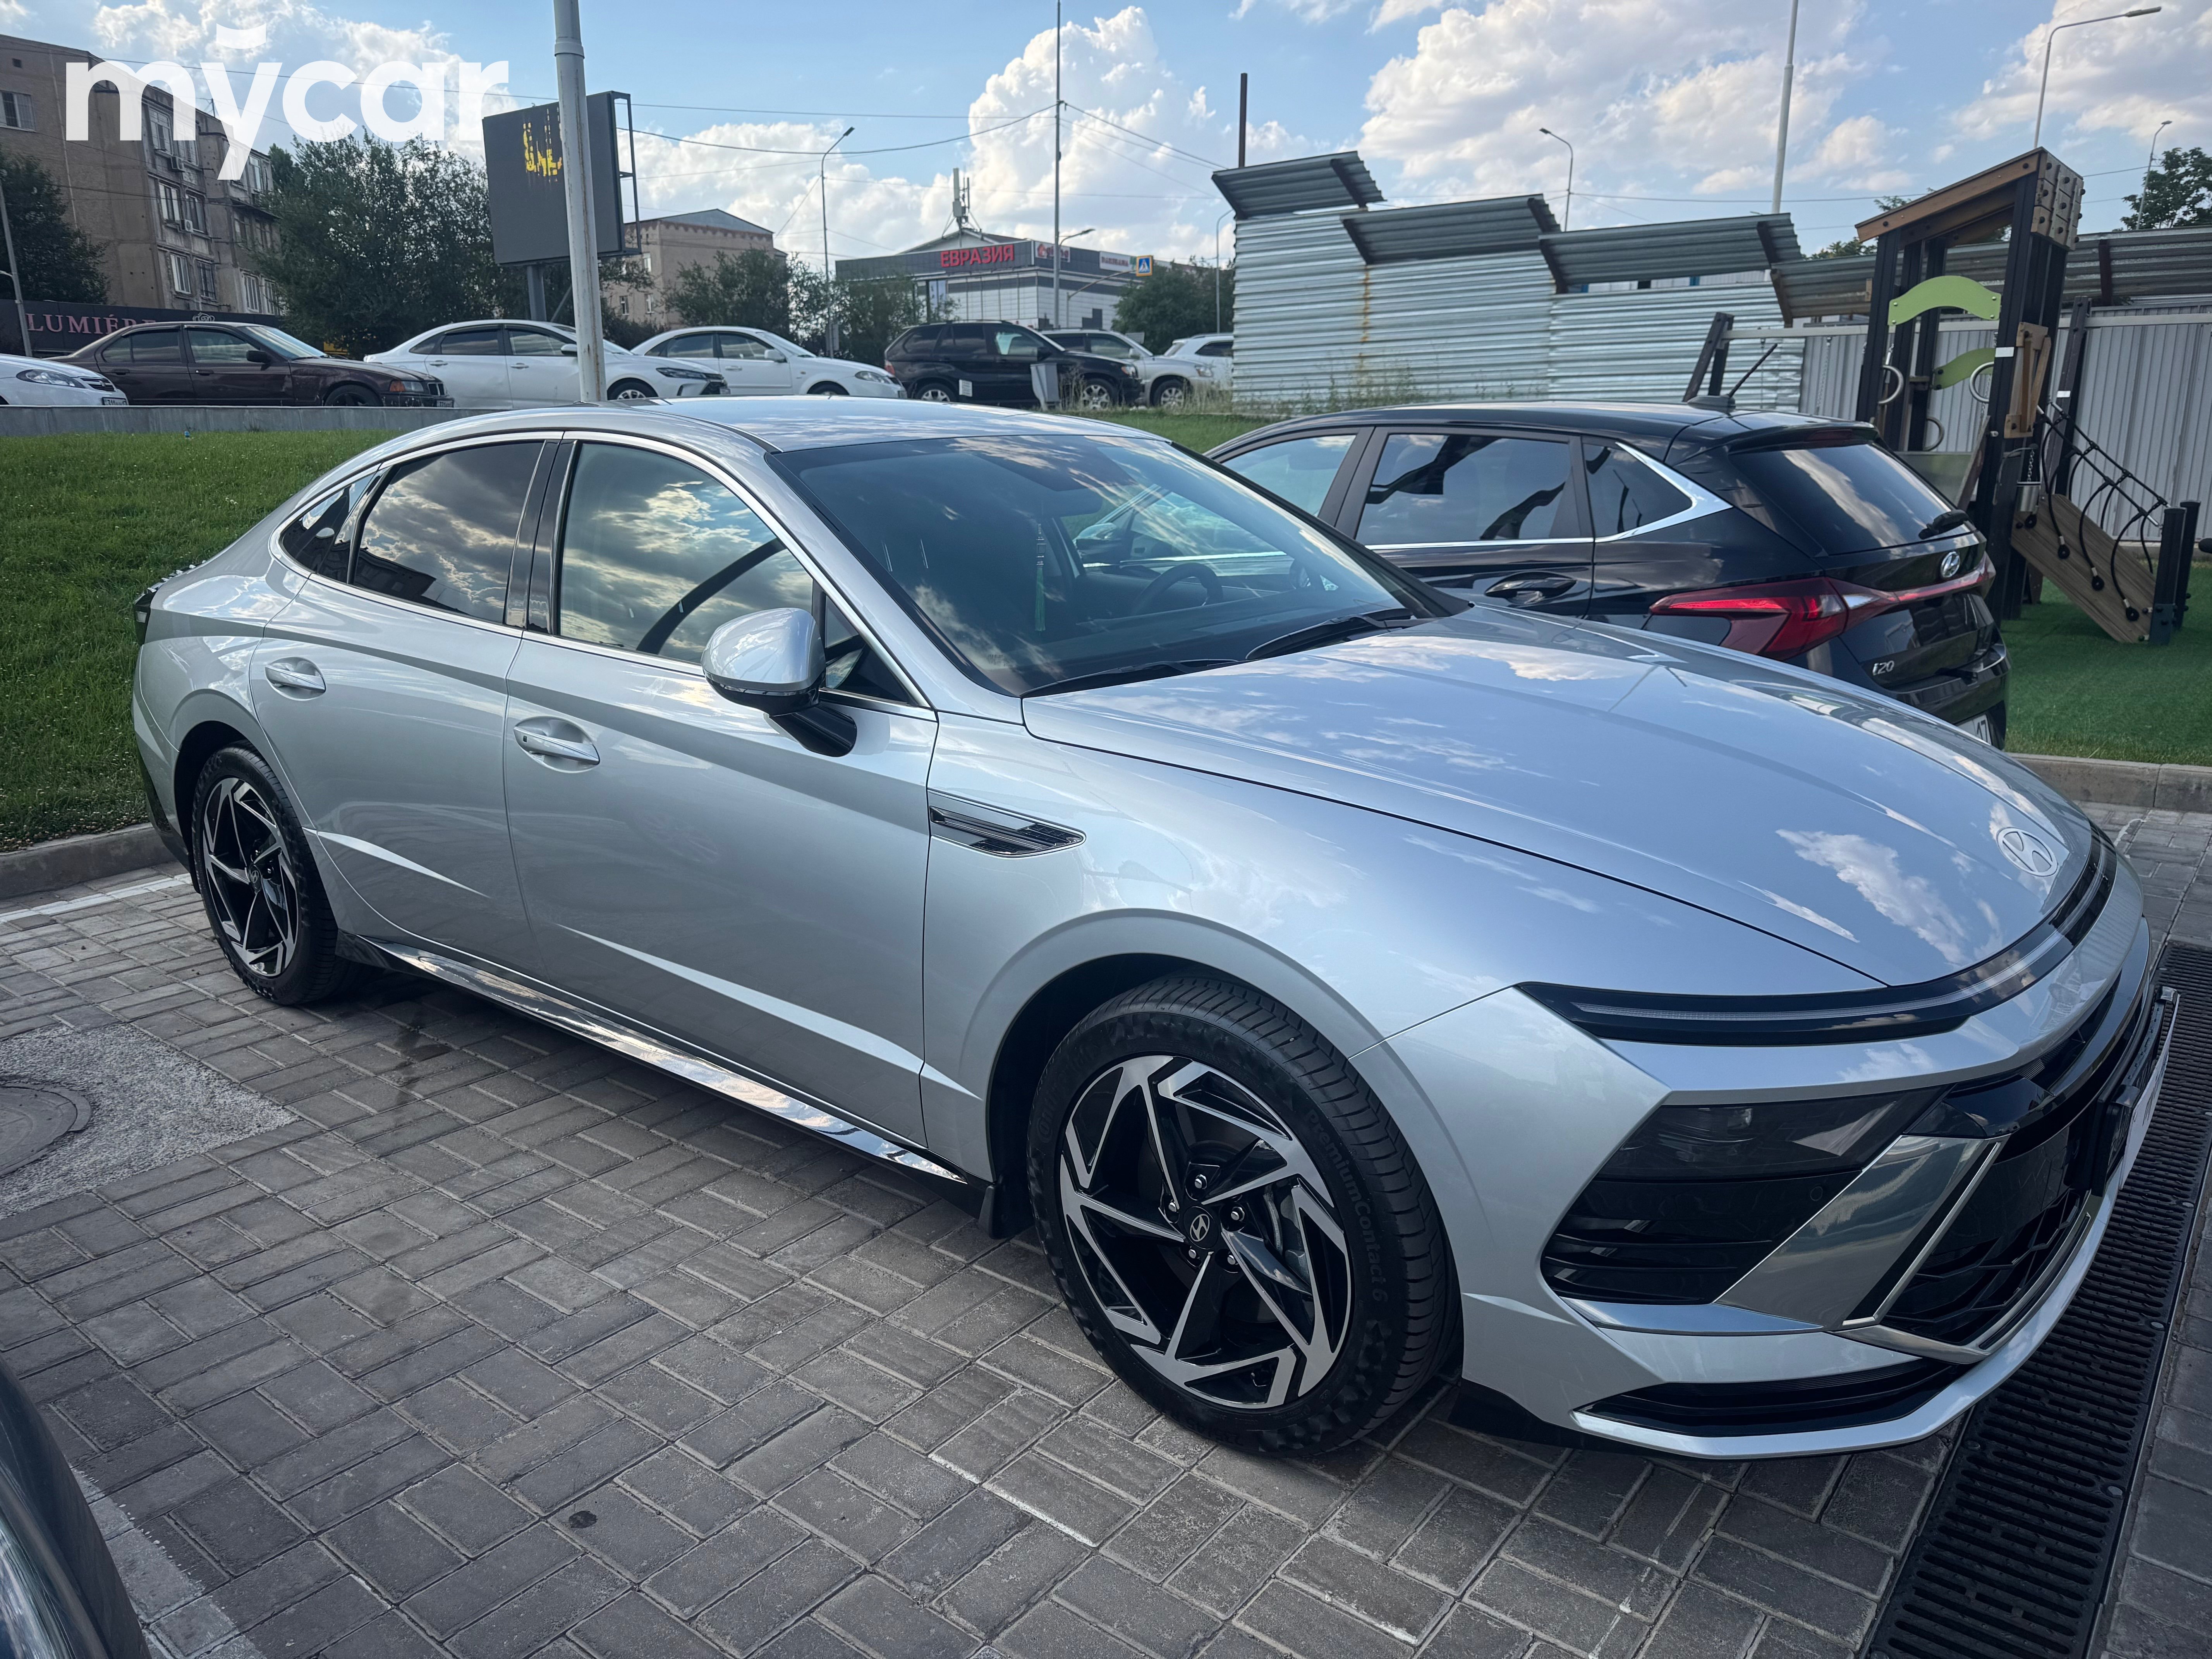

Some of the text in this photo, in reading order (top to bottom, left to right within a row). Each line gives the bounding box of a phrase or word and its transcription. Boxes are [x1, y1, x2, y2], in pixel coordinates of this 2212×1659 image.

[941, 244, 1014, 267] ЕВРАЗИЯ
[1873, 660, 1894, 675] i20
[1372, 1288, 1388, 1302] 6
